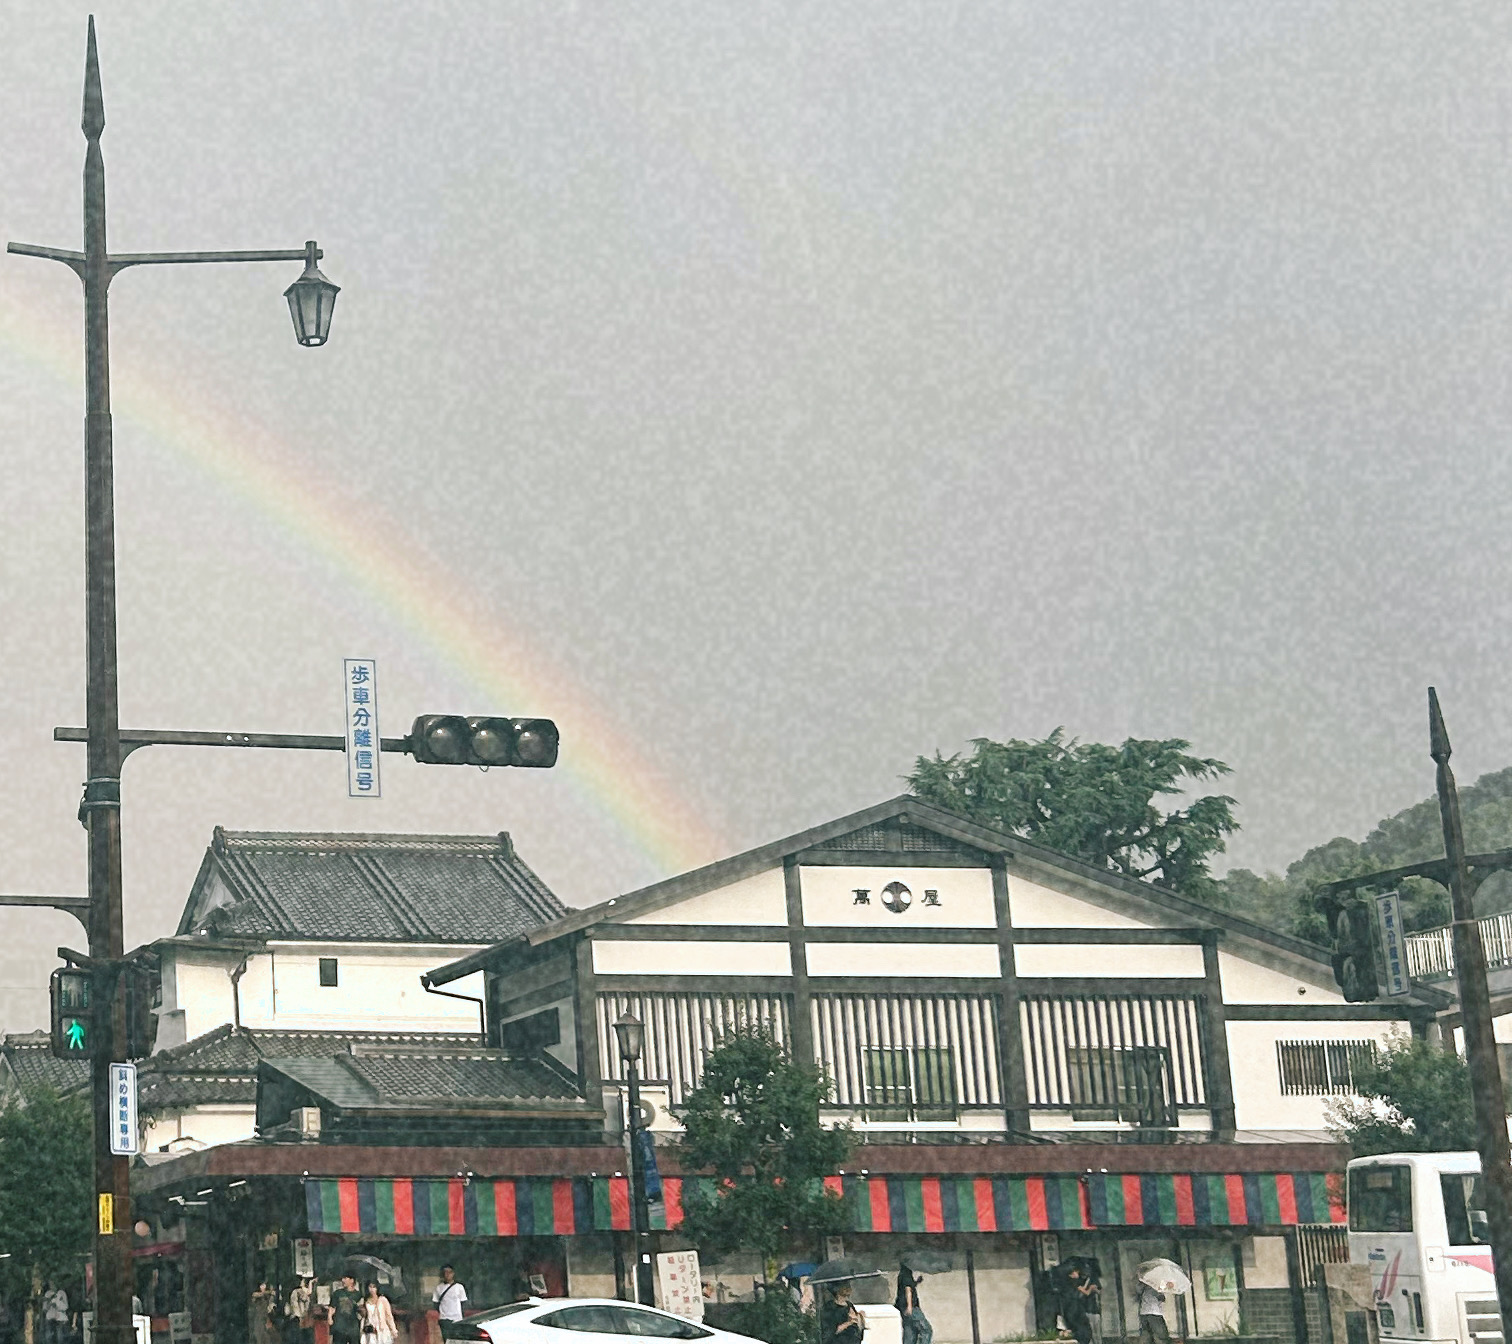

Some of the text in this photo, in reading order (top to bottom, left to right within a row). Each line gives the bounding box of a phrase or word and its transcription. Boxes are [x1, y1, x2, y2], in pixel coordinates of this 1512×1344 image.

[350, 665, 374, 791] 歩車分離信号
[118, 1068, 130, 1149] 斜め横断専用
